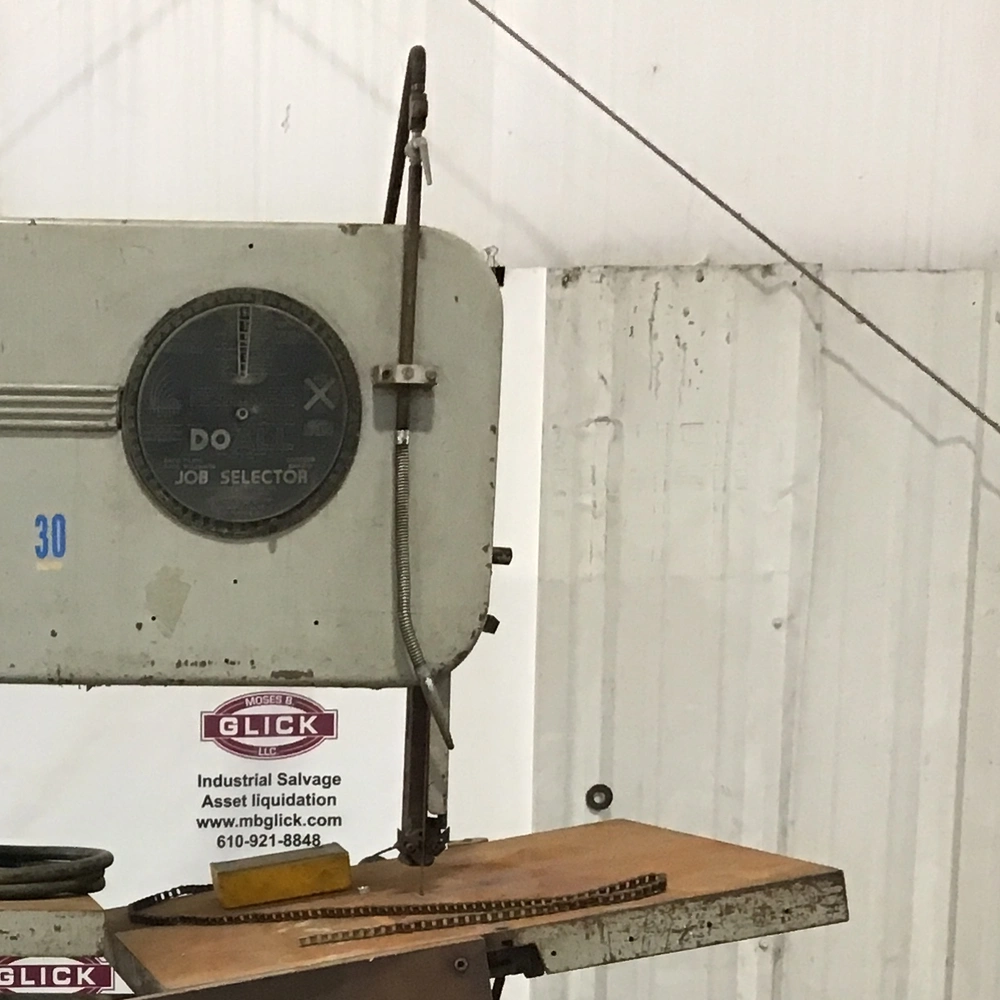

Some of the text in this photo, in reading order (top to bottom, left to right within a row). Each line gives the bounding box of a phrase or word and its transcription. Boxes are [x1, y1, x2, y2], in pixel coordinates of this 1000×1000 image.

[175, 469, 308, 485] JOB SELECTOR
[35, 513, 66, 559] 30
[245, 696, 282, 706] MOSES
[219, 716, 318, 736] GLICK
[198, 772, 341, 789] Industrial Salvage
[202, 793, 336, 810] Asset liquidation
[196, 813, 342, 830] www.mbglick.com
[217, 833, 321, 848] 610-921-8848
